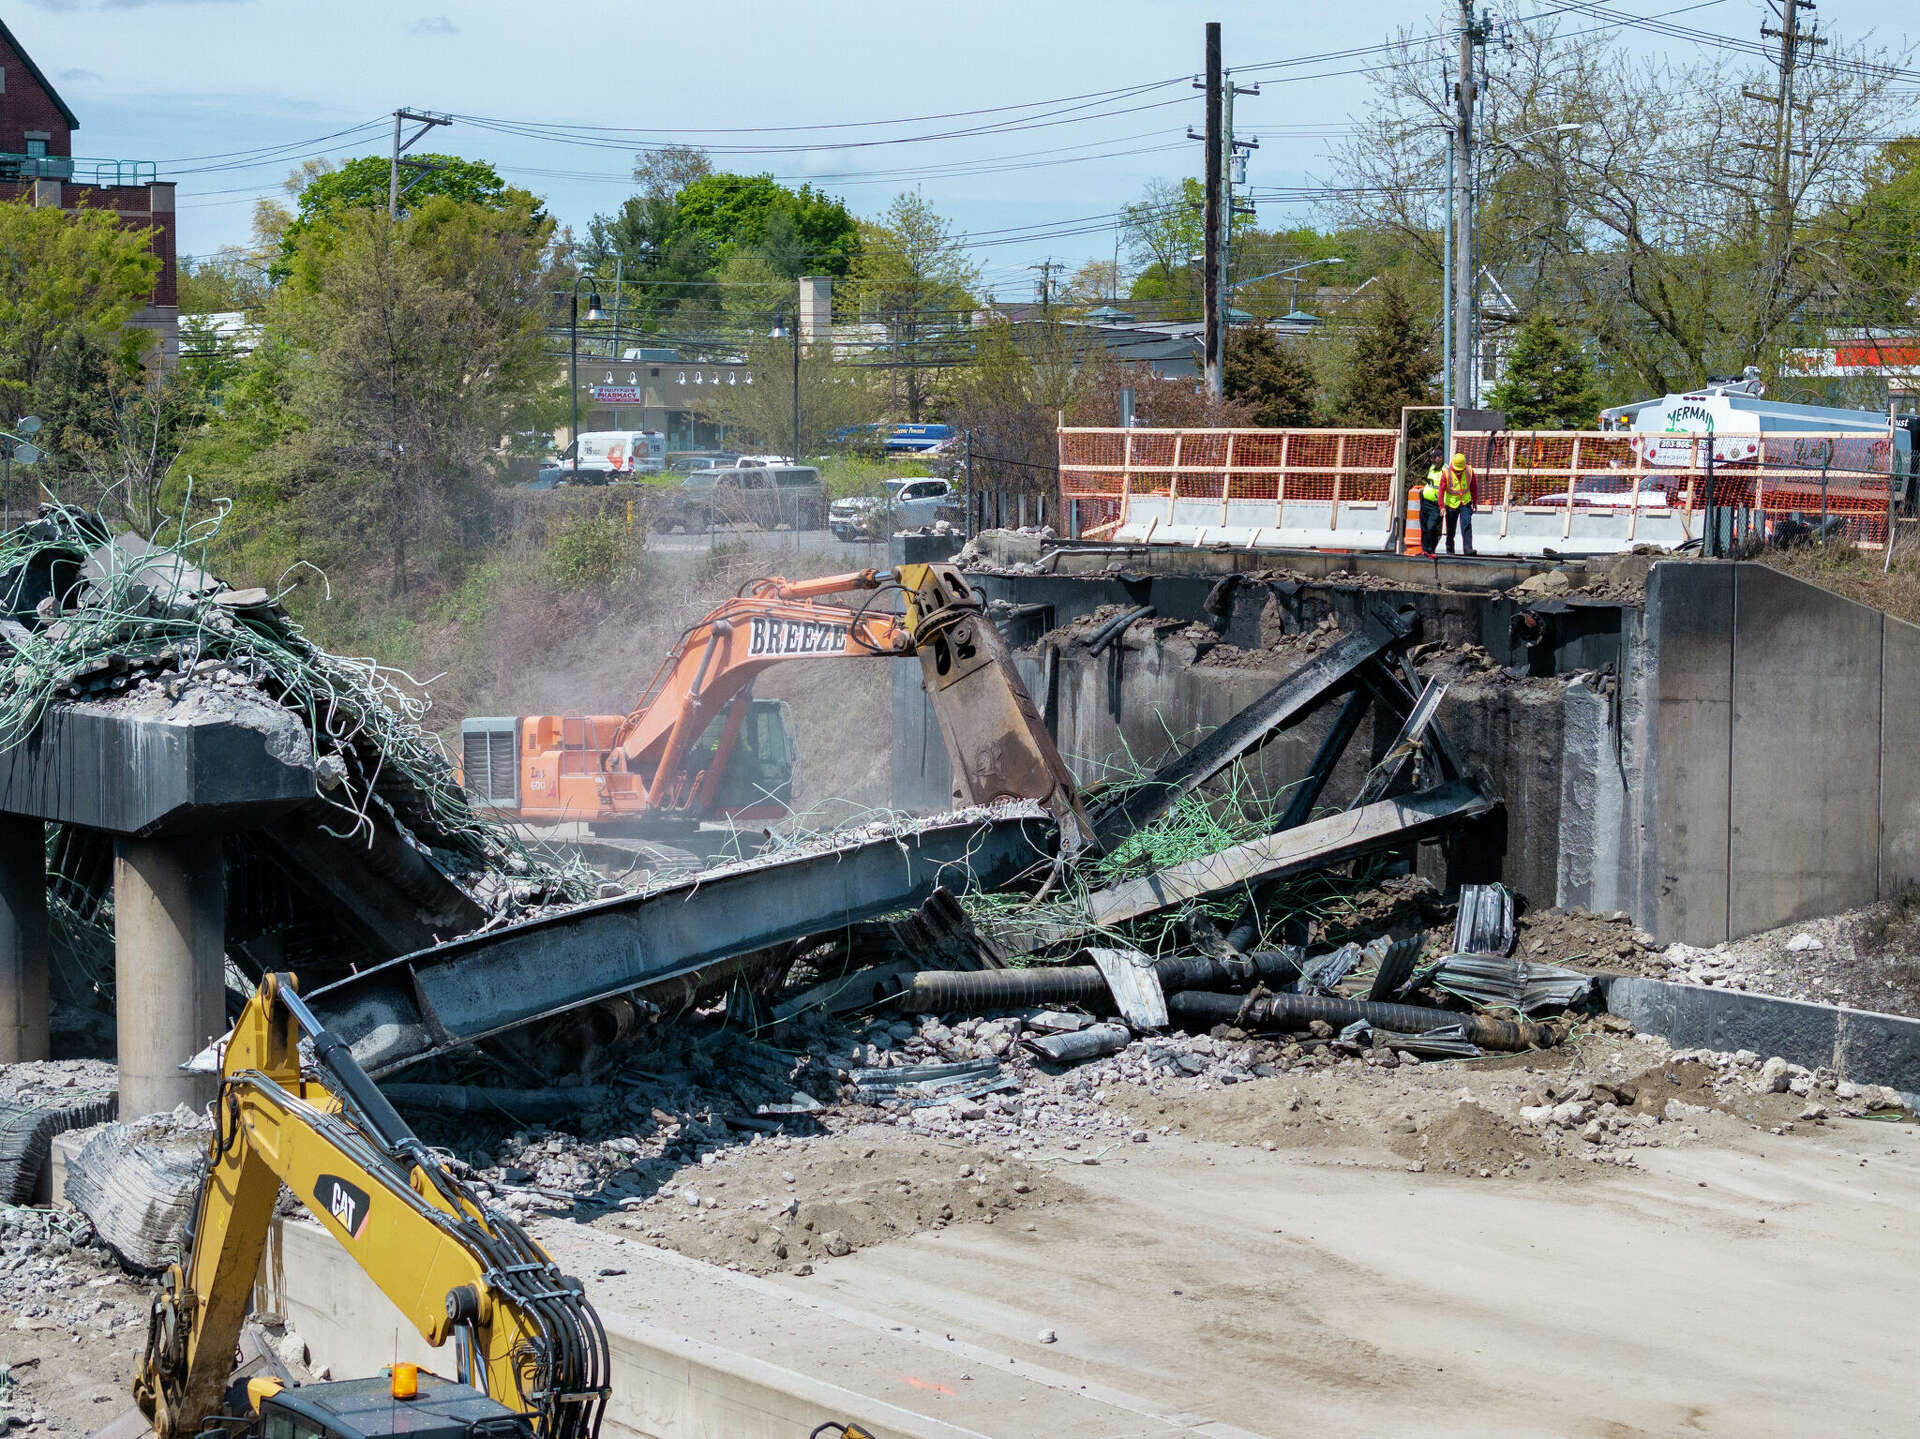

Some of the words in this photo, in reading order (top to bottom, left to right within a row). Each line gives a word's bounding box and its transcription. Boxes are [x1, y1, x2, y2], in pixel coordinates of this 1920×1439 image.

[1667, 406, 1714, 432] MERMAID
[1885, 416, 1909, 427] Tust
[749, 616, 848, 655] BREEZE
[331, 1181, 356, 1233] CAT
